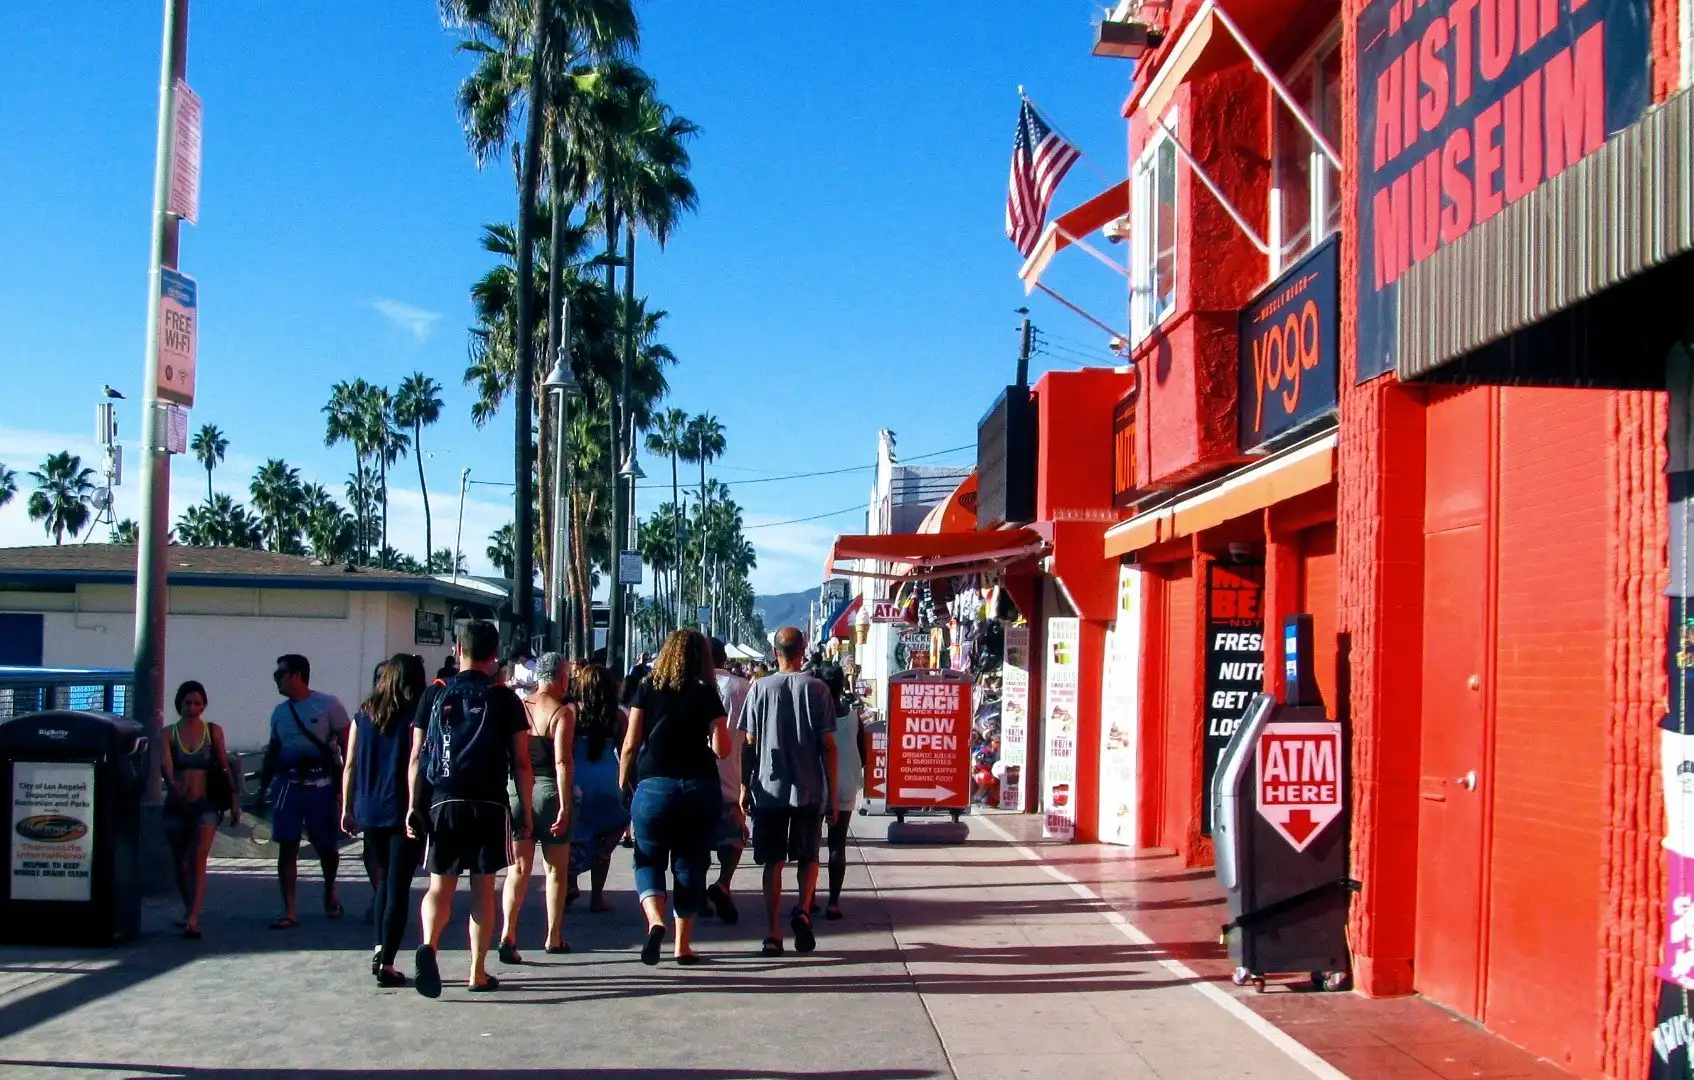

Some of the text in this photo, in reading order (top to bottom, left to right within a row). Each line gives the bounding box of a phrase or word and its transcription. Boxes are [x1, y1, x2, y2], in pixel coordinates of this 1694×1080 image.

[1374, 0, 1590, 172] HISTO
[1374, 21, 1605, 292] MUSEUM
[165, 308, 192, 335] FREE
[165, 327, 191, 354] WI-FI
[1253, 299, 1319, 432] yoga
[1212, 589, 1265, 618] BE
[900, 683, 960, 696] MUSCLE
[1212, 691, 1248, 709] GET
[900, 695, 959, 710] BEACH
[905, 717, 956, 734] NOW
[902, 734, 957, 751] OPEN
[1263, 740, 1336, 782] ATM
[20, 782, 33, 790] City
[57, 782, 87, 791] Angeles
[1265, 785, 1335, 803] HERE
